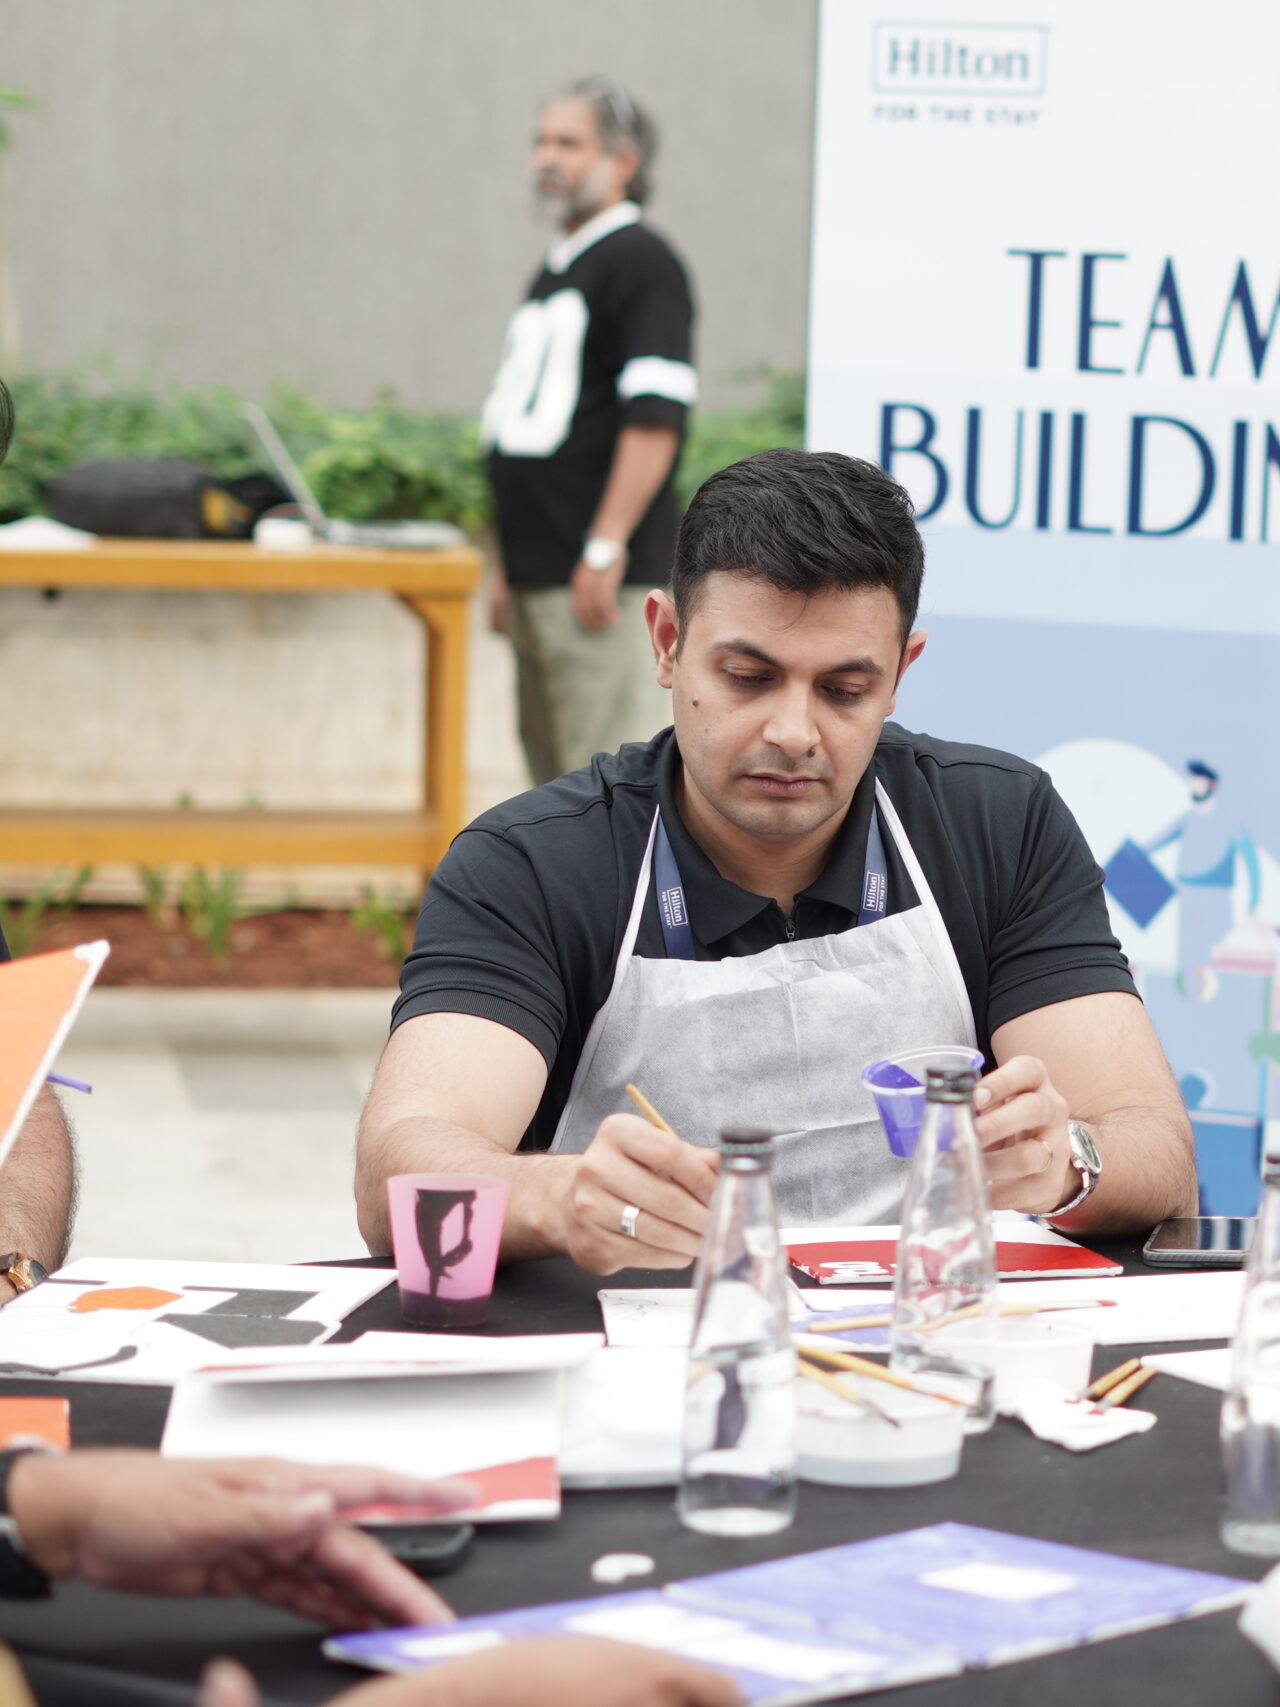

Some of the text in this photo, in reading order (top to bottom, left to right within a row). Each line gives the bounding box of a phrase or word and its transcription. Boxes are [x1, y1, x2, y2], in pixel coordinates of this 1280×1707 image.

[888, 37, 1030, 80] Hilton
[874, 105, 1041, 128] FOR THE STAY
[670, 890, 682, 922] Hilton
[866, 876, 877, 908] Hilton
